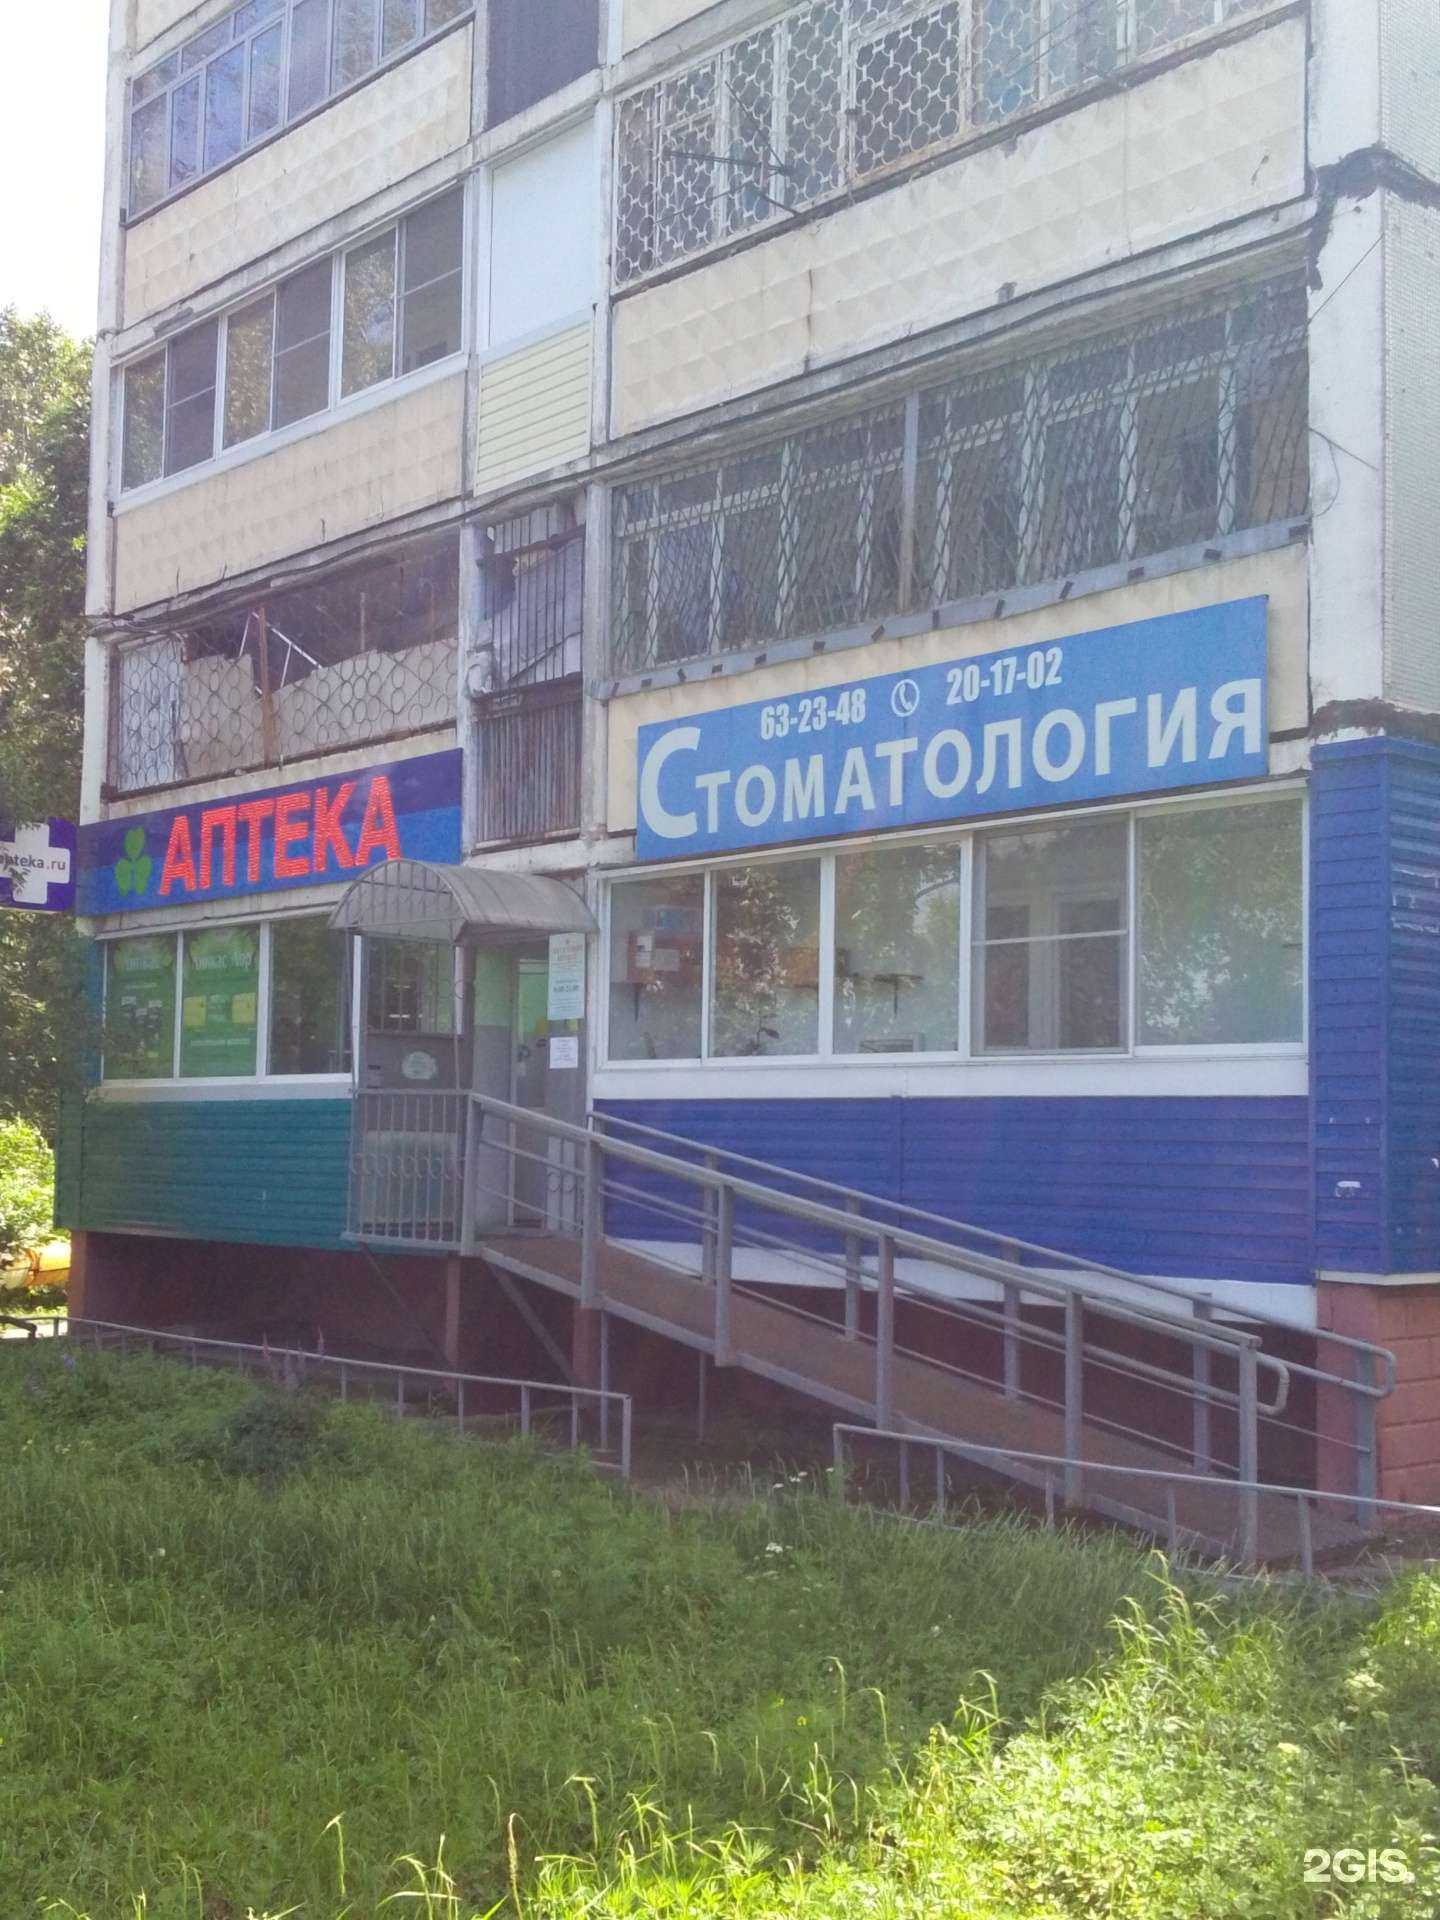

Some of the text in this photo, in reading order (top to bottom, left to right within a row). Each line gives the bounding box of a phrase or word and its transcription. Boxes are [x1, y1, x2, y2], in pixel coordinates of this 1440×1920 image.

[761, 646, 1063, 741] 63-23-48 20-17-02
[640, 677, 1263, 840] СТОМАТОЛОГИЯ
[159, 775, 401, 896] АПТЕКА
